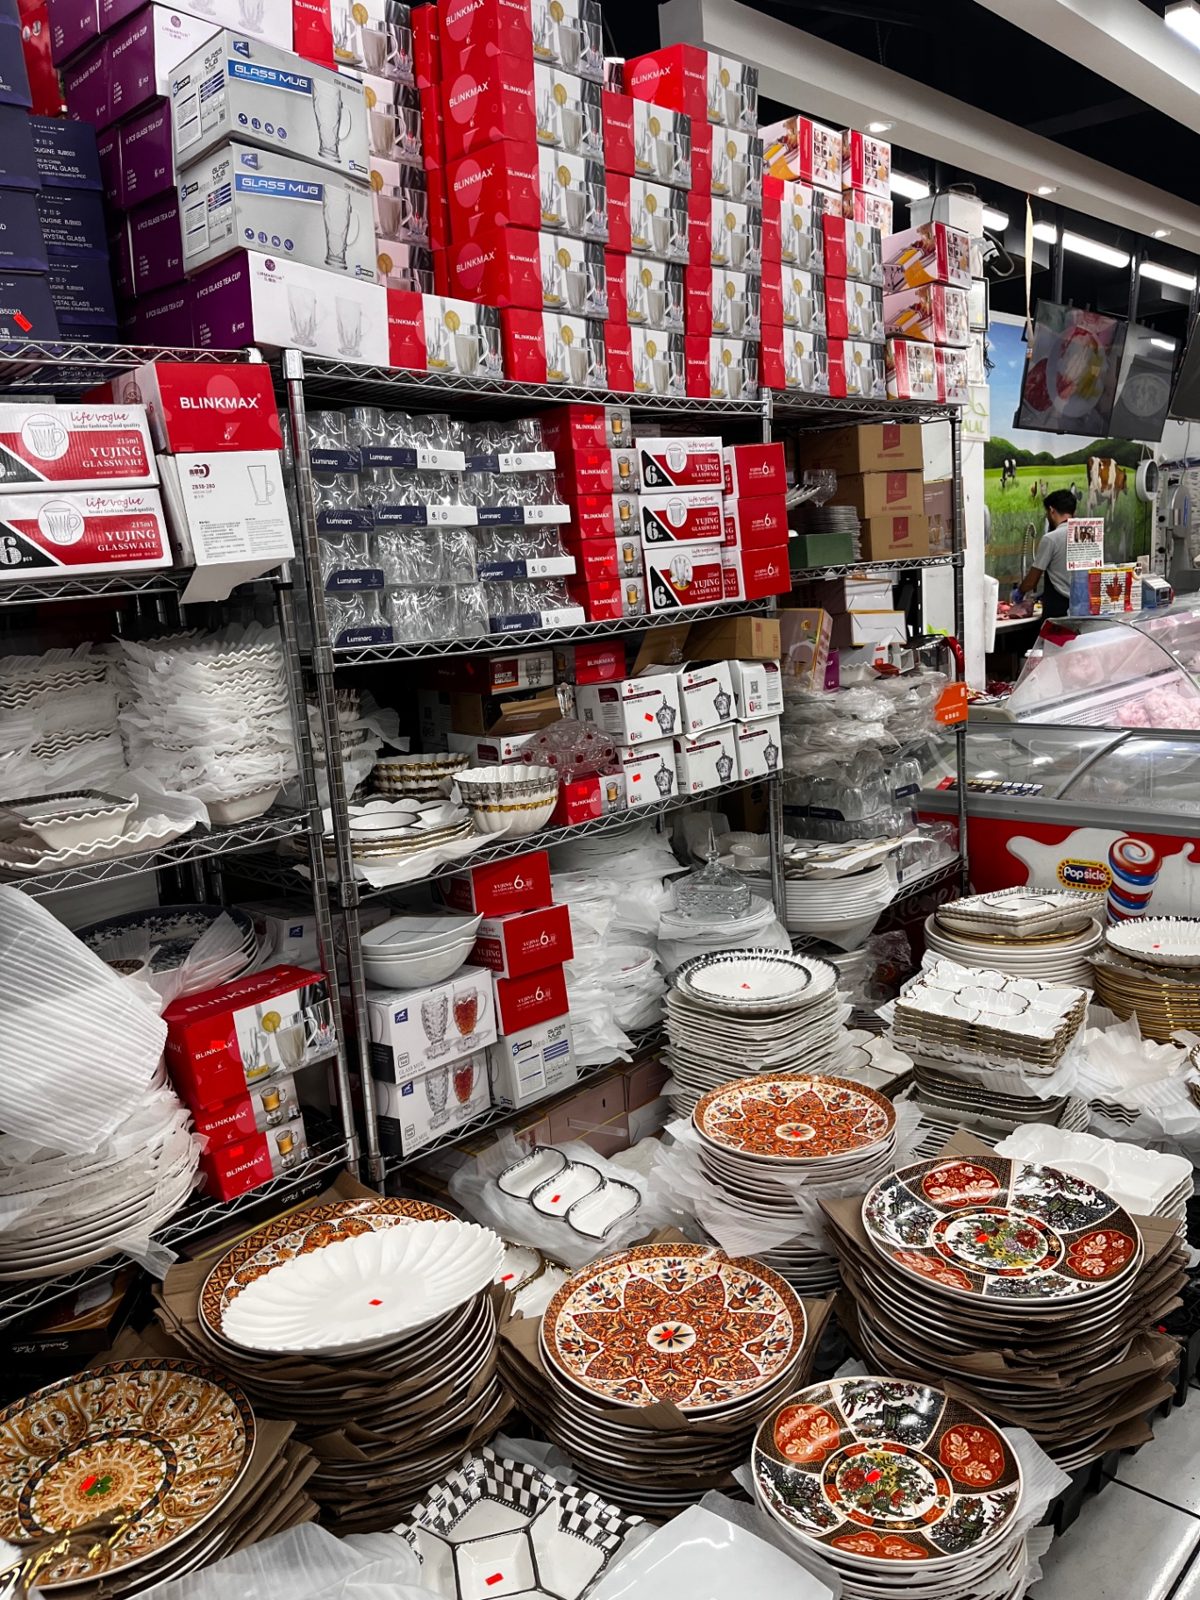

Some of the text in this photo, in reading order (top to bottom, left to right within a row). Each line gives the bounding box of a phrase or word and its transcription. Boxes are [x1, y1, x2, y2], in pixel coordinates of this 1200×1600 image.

[295, 0, 326, 14] BLINKMAX
[446, 0, 485, 26] BLINKMAX
[234, 64, 278, 80] GLASS
[279, 72, 309, 88] MUG
[631, 67, 671, 86] BLINKMAX
[449, 82, 489, 108] BLINKMAX
[503, 84, 532, 97] BLINKMAX
[37, 163, 80, 173] RYSTAL GLASS
[211, 159, 230, 175] GLASS
[212, 169, 226, 181] MUG
[453, 168, 493, 191] BLINKMAX
[507, 170, 536, 180] BLINKMAX
[241, 177, 320, 195] GLASS MUG
[168, 209, 177, 218] CUP
[43, 233, 66, 241] RYSTAL
[456, 252, 495, 273] BLINKMAX
[510, 254, 537, 264] BLINKMAX
[208, 280, 223, 293] GLASS
[222, 276, 232, 286] TEA
[231, 271, 241, 282] CUP
[389, 317, 420, 327] BLINKMAX
[514, 333, 542, 342] BLINKMAX
[180, 396, 259, 409] BLINKMAX
[71, 411, 130, 425] life vogue
[961, 419, 985, 433] ALAL
[116, 437, 139, 445] 215ml
[90, 446, 142, 458] YUJING
[369, 453, 393, 461] Luminarc
[82, 458, 144, 469] GLASSWARE
[312, 457, 339, 466] Luminarc
[695, 463, 719, 471] YUJING
[762, 461, 769, 475] 6
[645, 464, 658, 485] 6
[86, 497, 145, 510] life vogue
[326, 517, 353, 525] Luminarc
[378, 511, 402, 520] Luminarc
[695, 517, 719, 525] YUJING
[764, 513, 772, 527] 6
[131, 520, 153, 529] 215ml
[646, 521, 659, 540] 6
[105, 530, 156, 542] YUJING
[0, 536, 22, 565] 6
[97, 541, 159, 552] GLASSWARE
[767, 562, 774, 576] 6
[337, 577, 362, 585] Luminarc
[694, 578, 720, 589] YUJING
[654, 585, 667, 607] 6
[689, 588, 720, 596] GLASSWARE
[587, 657, 616, 667] BLINKMAX
[572, 797, 598, 807] BLINKMAX
[513, 874, 524, 890] 6
[523, 938, 540, 947] YUJING
[539, 930, 550, 946] 6
[185, 976, 280, 1012] BLINKMAX
[535, 986, 544, 1001] 6
[205, 1112, 247, 1131] BLINKMAX
[226, 1157, 264, 1178] BLINKMAX
[301, 1180, 322, 1195] Snack
[40, 1340, 70, 1352] Snack
